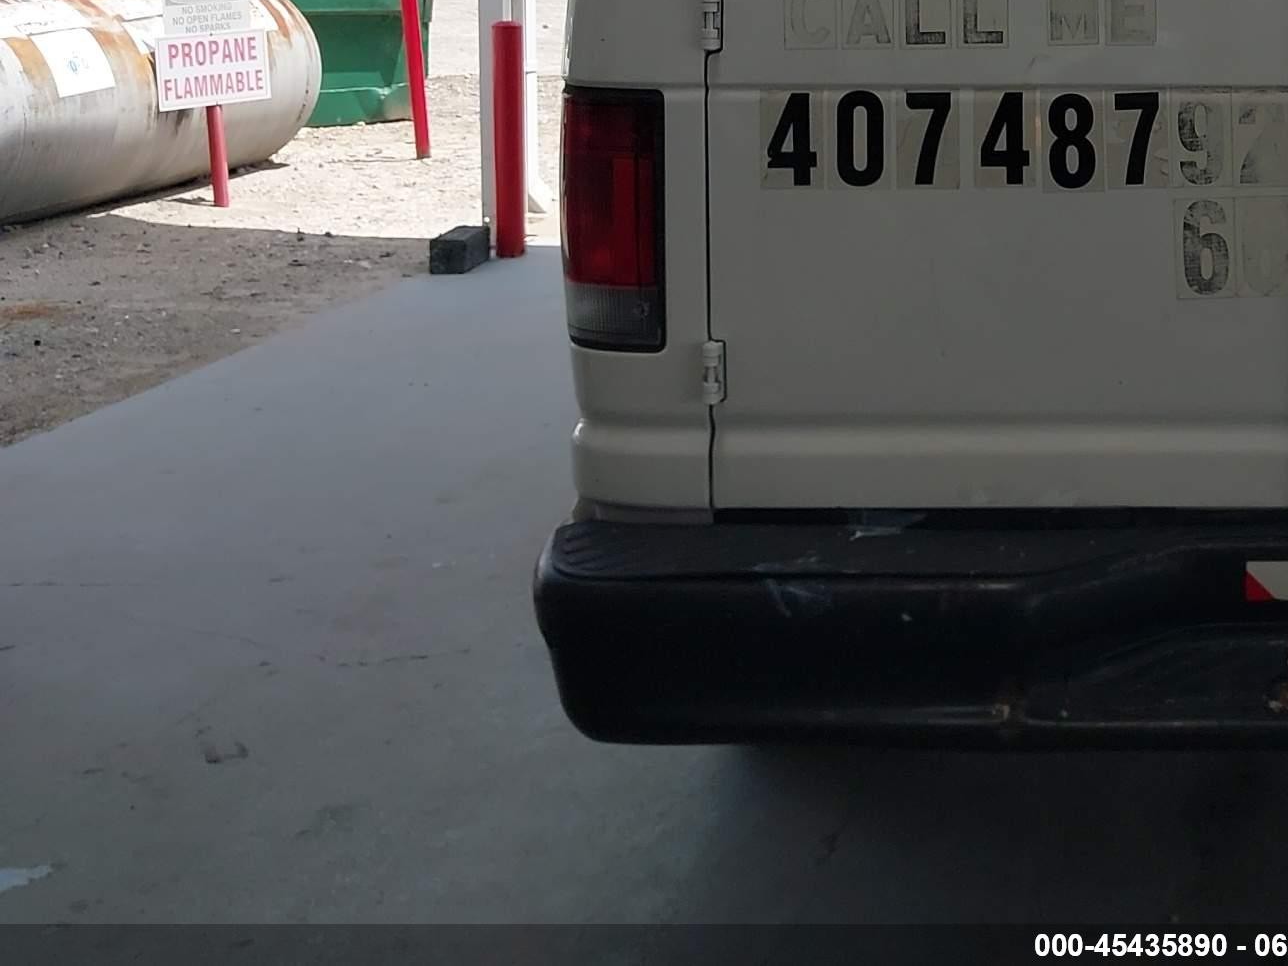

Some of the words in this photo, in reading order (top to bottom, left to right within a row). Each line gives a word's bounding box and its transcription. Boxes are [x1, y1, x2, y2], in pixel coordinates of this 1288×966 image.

[182, 6, 194, 15] NO
[195, 2, 232, 13] SMOKING
[172, 17, 184, 26] NO
[186, 14, 208, 25] OPEN
[210, 11, 242, 22] FLAMES
[185, 25, 197, 34] NO
[199, 22, 231, 33] SPARKS
[167, 36, 257, 69] PROPANE
[163, 70, 263, 101] FLAMMABLE
